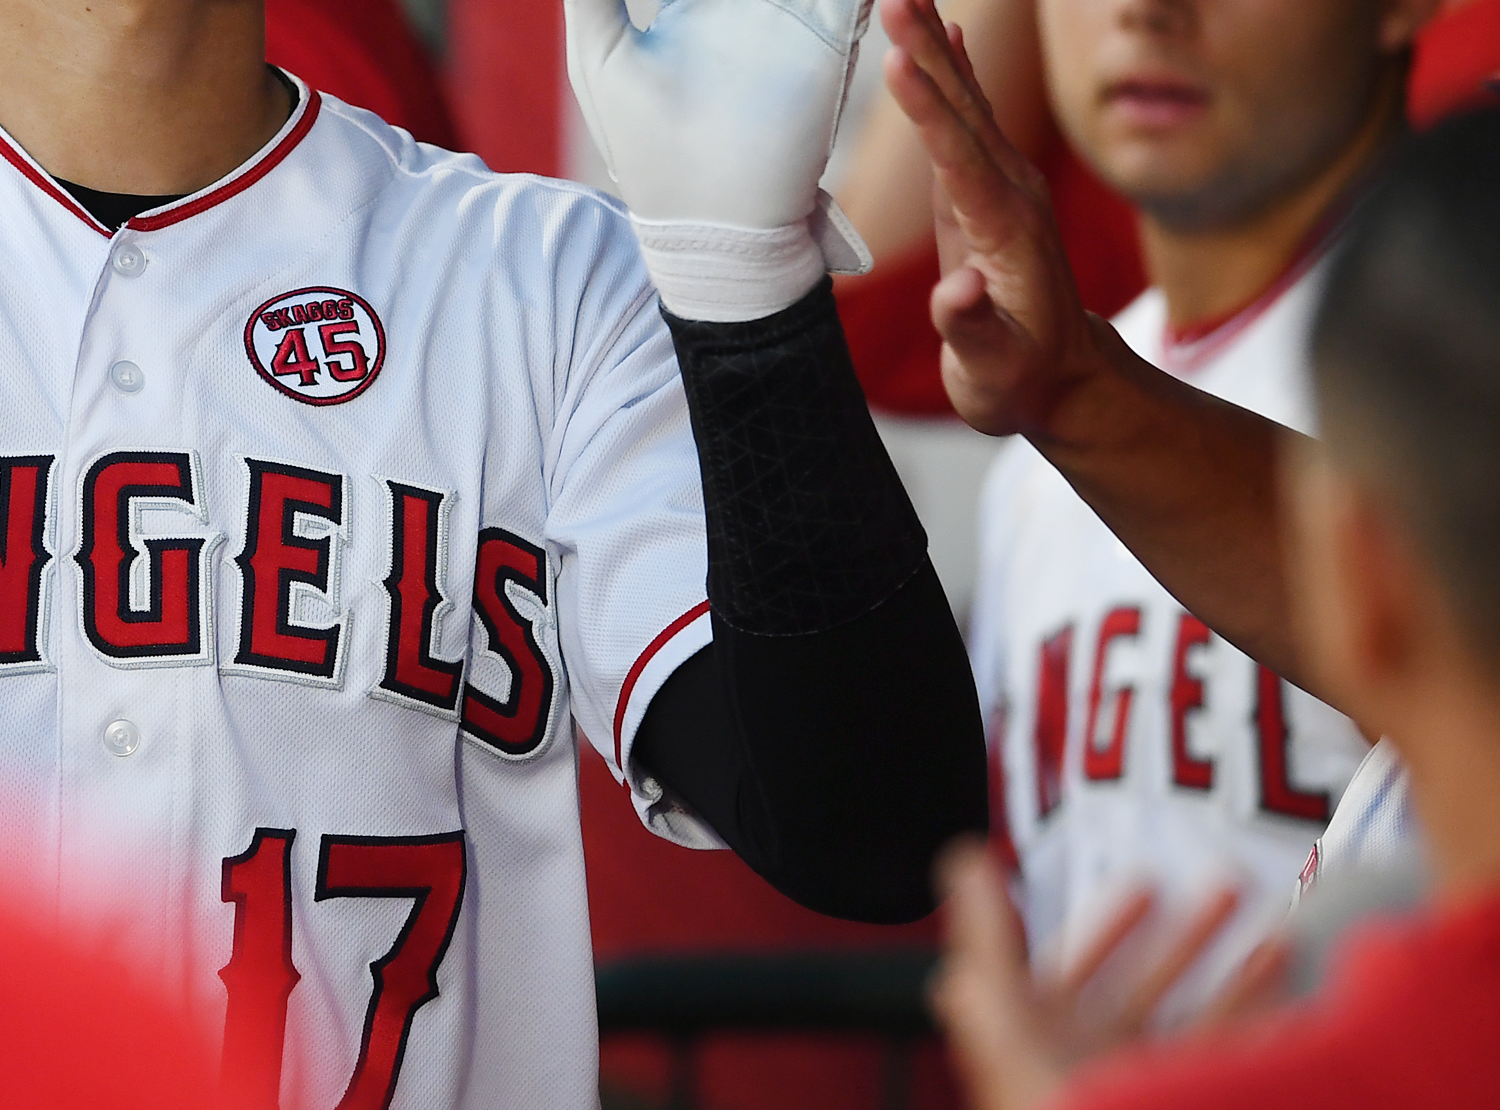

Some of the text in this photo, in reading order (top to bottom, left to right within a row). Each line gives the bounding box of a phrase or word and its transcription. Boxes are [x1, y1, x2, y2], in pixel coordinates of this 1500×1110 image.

[260, 297, 355, 331] SKAGGS
[270, 320, 370, 387] 45
[218, 828, 467, 1110] 17
